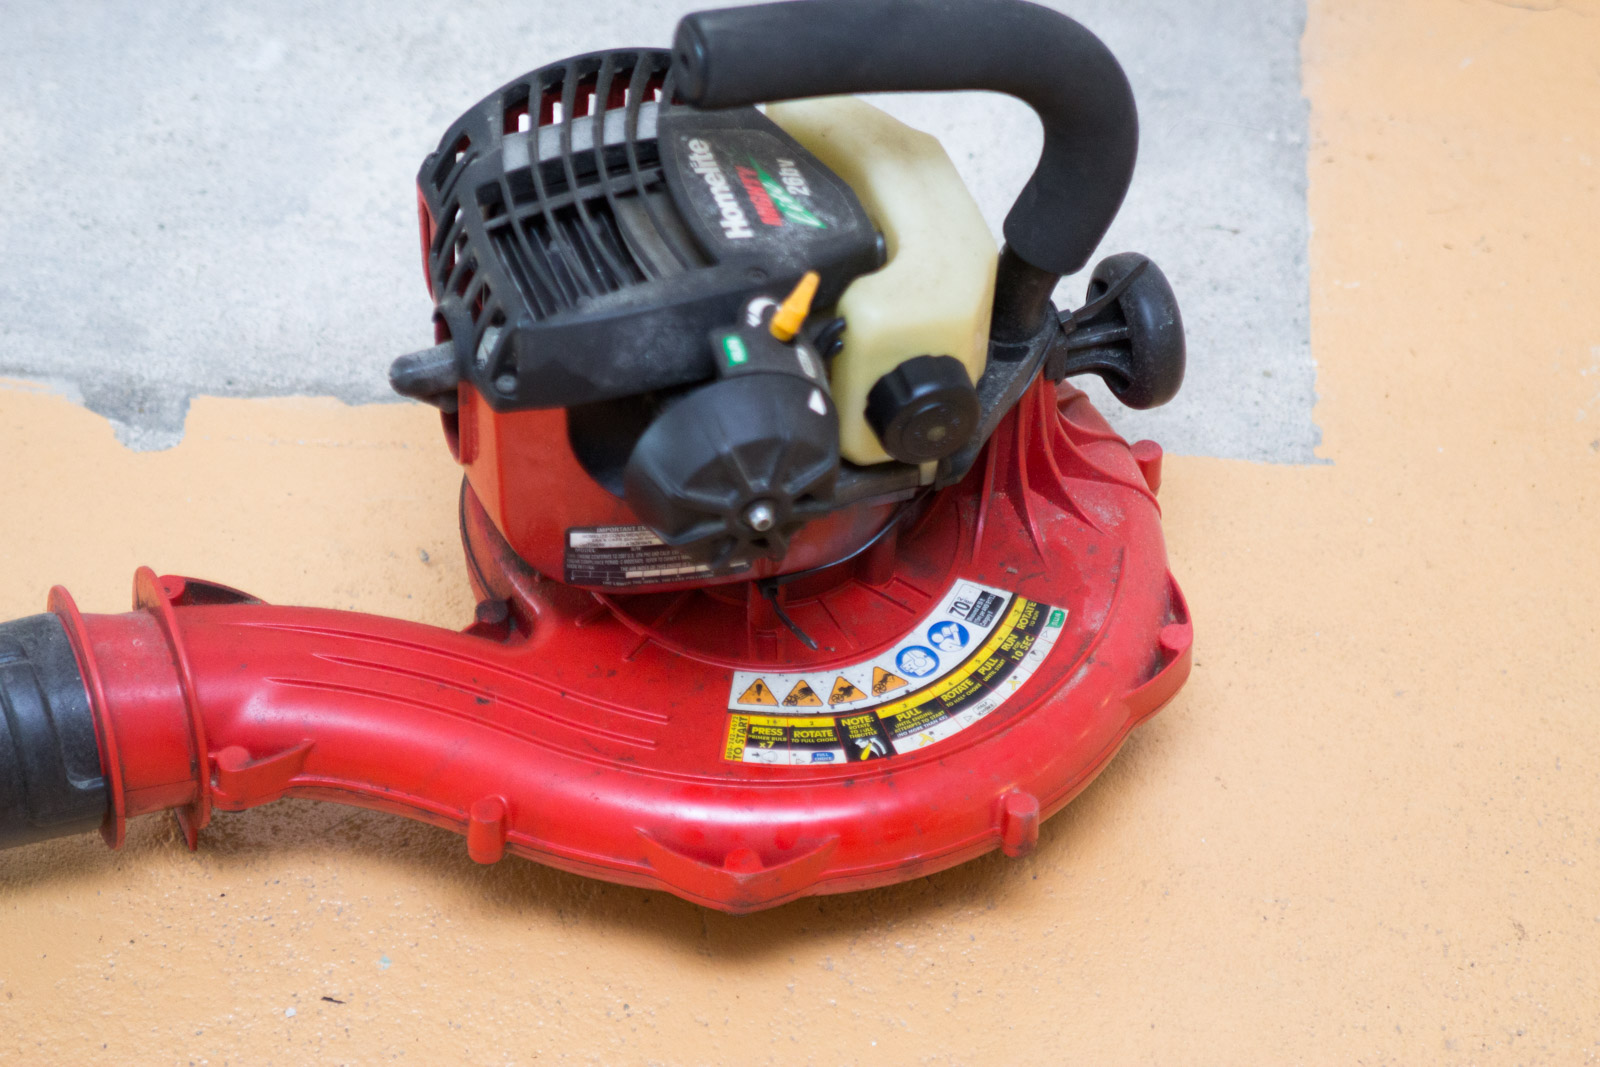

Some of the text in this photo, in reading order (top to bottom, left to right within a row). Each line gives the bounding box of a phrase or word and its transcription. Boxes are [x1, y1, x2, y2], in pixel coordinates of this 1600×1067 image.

[688, 138, 754, 239] Homelite
[948, 600, 971, 618] 70
[1016, 601, 1037, 630] ROTATE
[1001, 634, 1019, 652] RUN
[1011, 635, 1035, 661] 10 SEC
[977, 658, 999, 676] PULL
[940, 678, 974, 702] ROTATE
[841, 715, 874, 727] NOTE:
[894, 720, 922, 734] ATTEMPTS
[929, 710, 945, 721] START
[895, 719, 912, 729] UNTIL
[896, 708, 922, 722] PULL
[751, 726, 784, 737] PRESS
[793, 729, 834, 739] ROTATE
[908, 725, 923, 734] MORE
[923, 719, 939, 729] THAN
[732, 716, 748, 761] TO START
